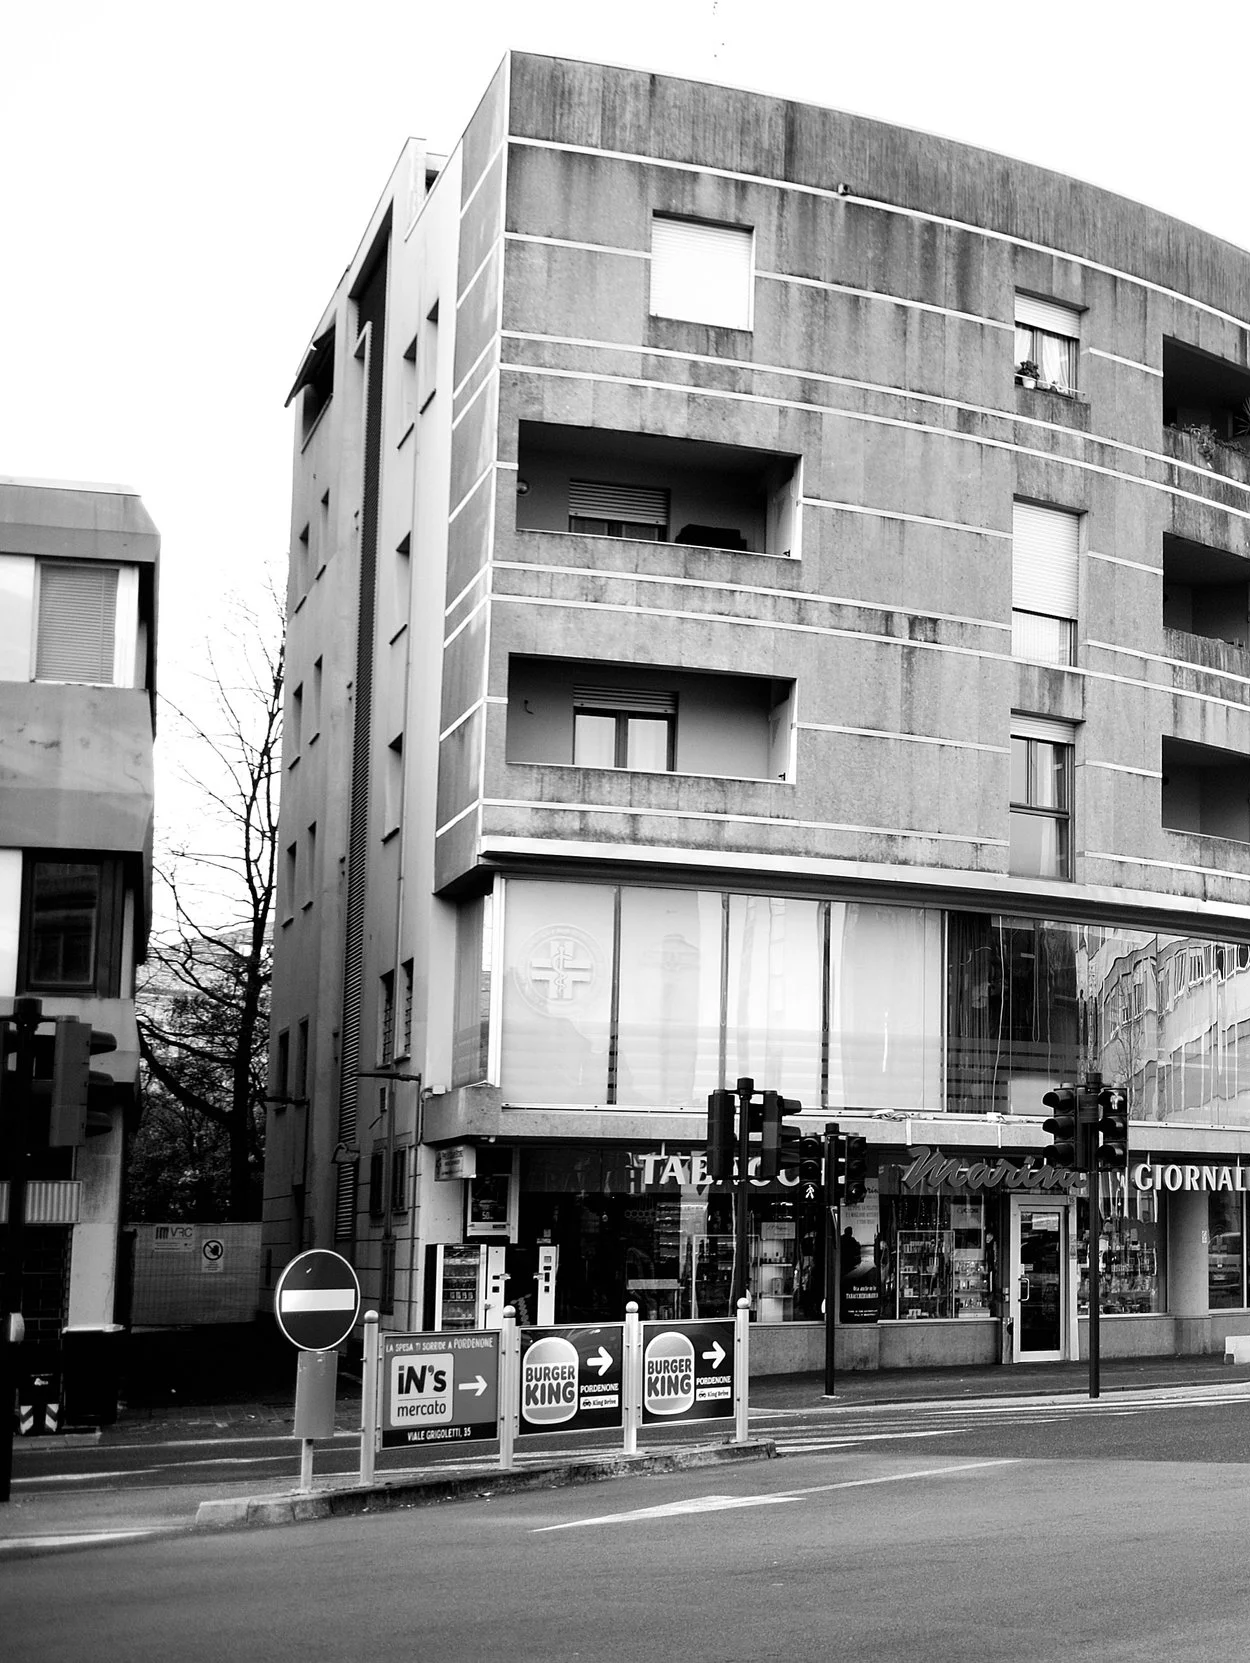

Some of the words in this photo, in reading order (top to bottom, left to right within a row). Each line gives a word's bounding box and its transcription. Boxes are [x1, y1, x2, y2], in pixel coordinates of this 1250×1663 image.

[901, 1145, 1089, 1190] Marina
[386, 1344, 394, 1352] LA
[395, 1343, 414, 1352] SPESA
[422, 1341, 446, 1351] SORRIDE
[448, 1341, 453, 1350] A
[453, 1337, 494, 1349] PORDENONE
[525, 1365, 575, 1383] BURGER
[647, 1358, 692, 1375] BURGER
[398, 1364, 447, 1395] iN's
[580, 1383, 619, 1393] PORDENONE
[647, 1373, 692, 1397] KING
[696, 1375, 732, 1386] PORDENONE
[525, 1381, 575, 1406] KING
[397, 1400, 446, 1417] mercato
[407, 1430, 425, 1441] VIALE
[426, 1427, 462, 1440] GRIGOLETTI,
[464, 1427, 471, 1437] 35
